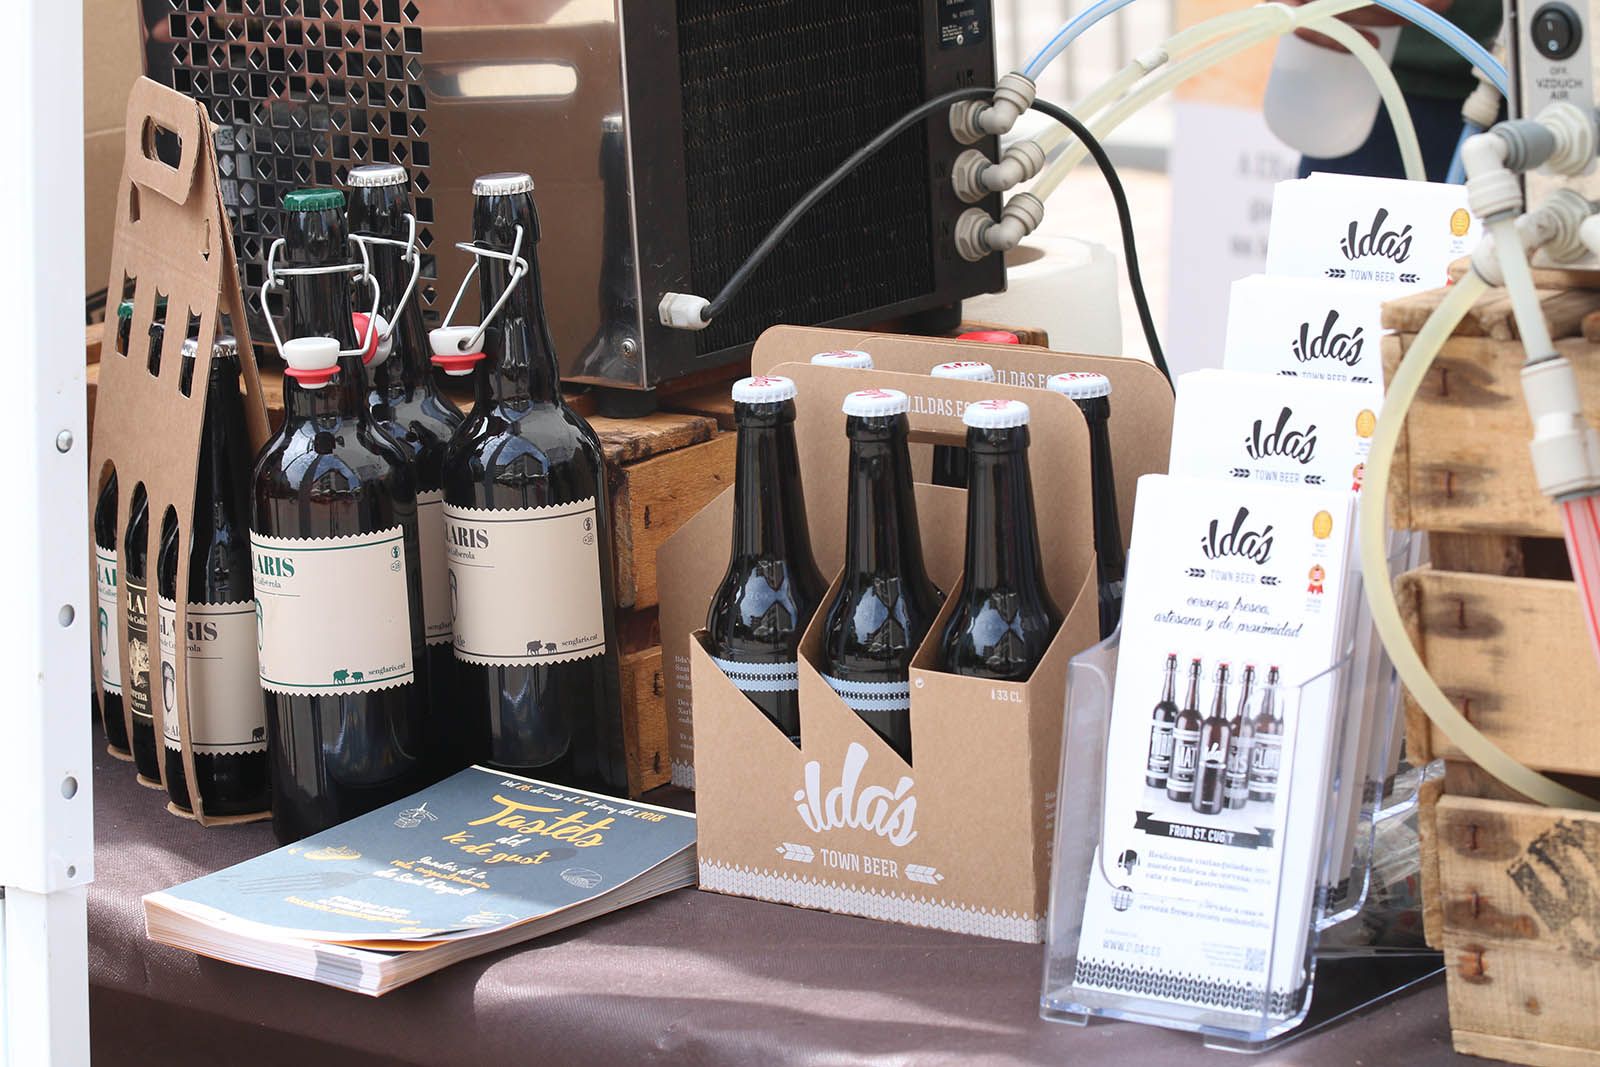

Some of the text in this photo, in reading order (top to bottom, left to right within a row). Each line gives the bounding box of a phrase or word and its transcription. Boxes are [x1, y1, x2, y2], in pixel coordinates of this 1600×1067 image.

[1350, 269, 1395, 283] TOWN BEER
[1255, 469, 1300, 484] TOWN BEER
[1154, 610, 1201, 627] artesana
[467, 794, 615, 848] Tastets
[633, 811, 667, 822] 2018
[495, 834, 532, 848] del
[1168, 824, 1194, 839] FROM
[1194, 828, 1208, 841] ST.
[460, 842, 496, 855] de
[484, 851, 551, 865] gust
[820, 848, 898, 880] TOWN BEER
